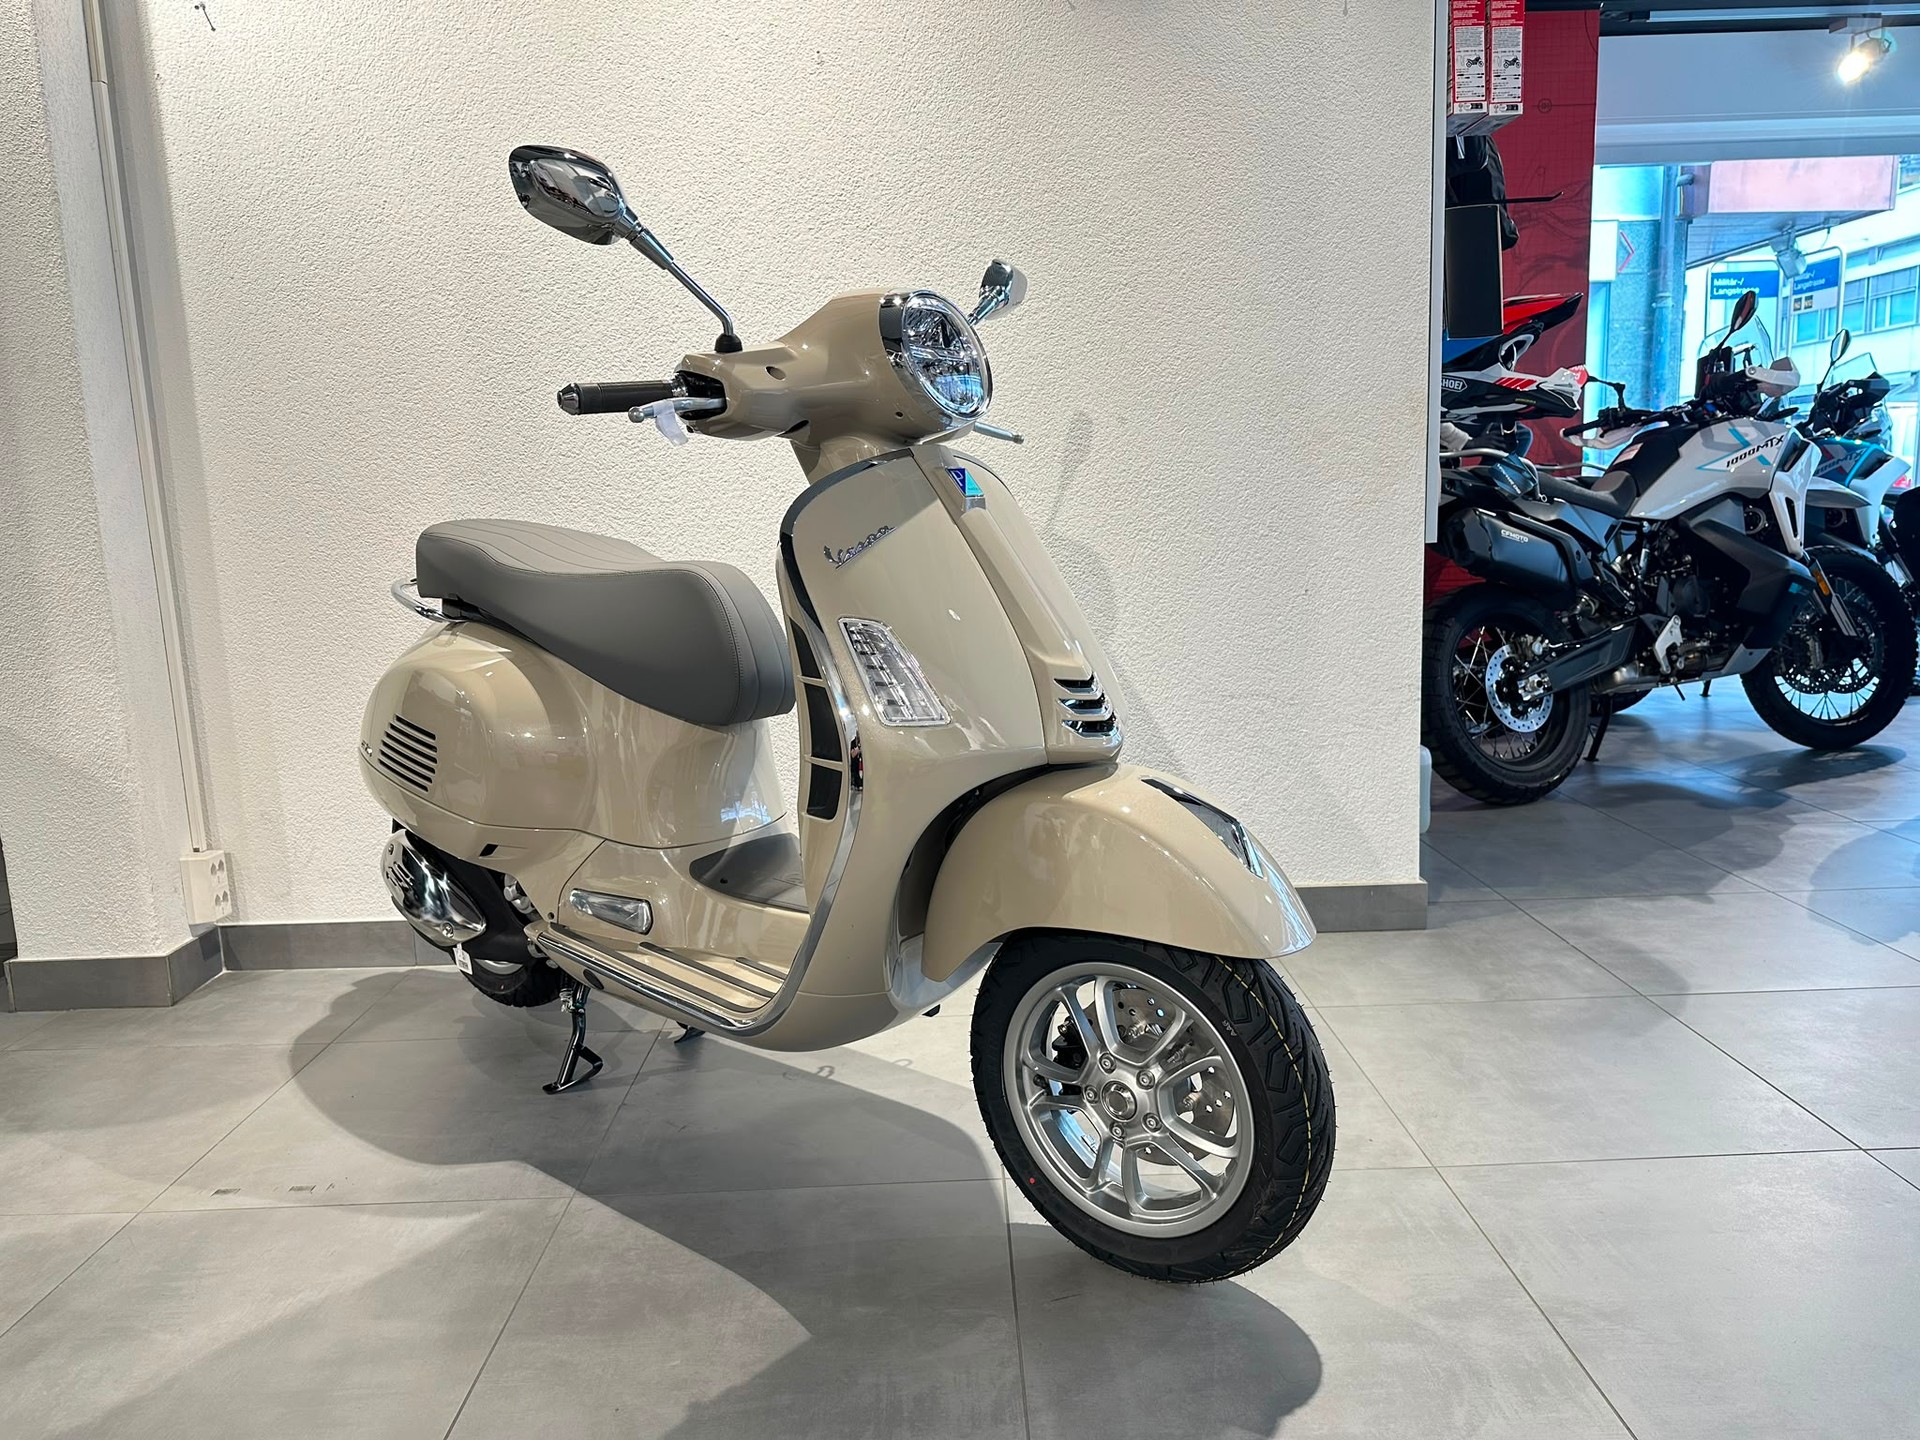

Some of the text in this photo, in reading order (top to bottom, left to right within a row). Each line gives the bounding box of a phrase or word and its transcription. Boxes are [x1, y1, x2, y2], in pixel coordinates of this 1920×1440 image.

[1726, 434, 1784, 468] 1000MTX
[823, 525, 897, 570] Vespa
[1501, 529, 1529, 543] CFMOTO
